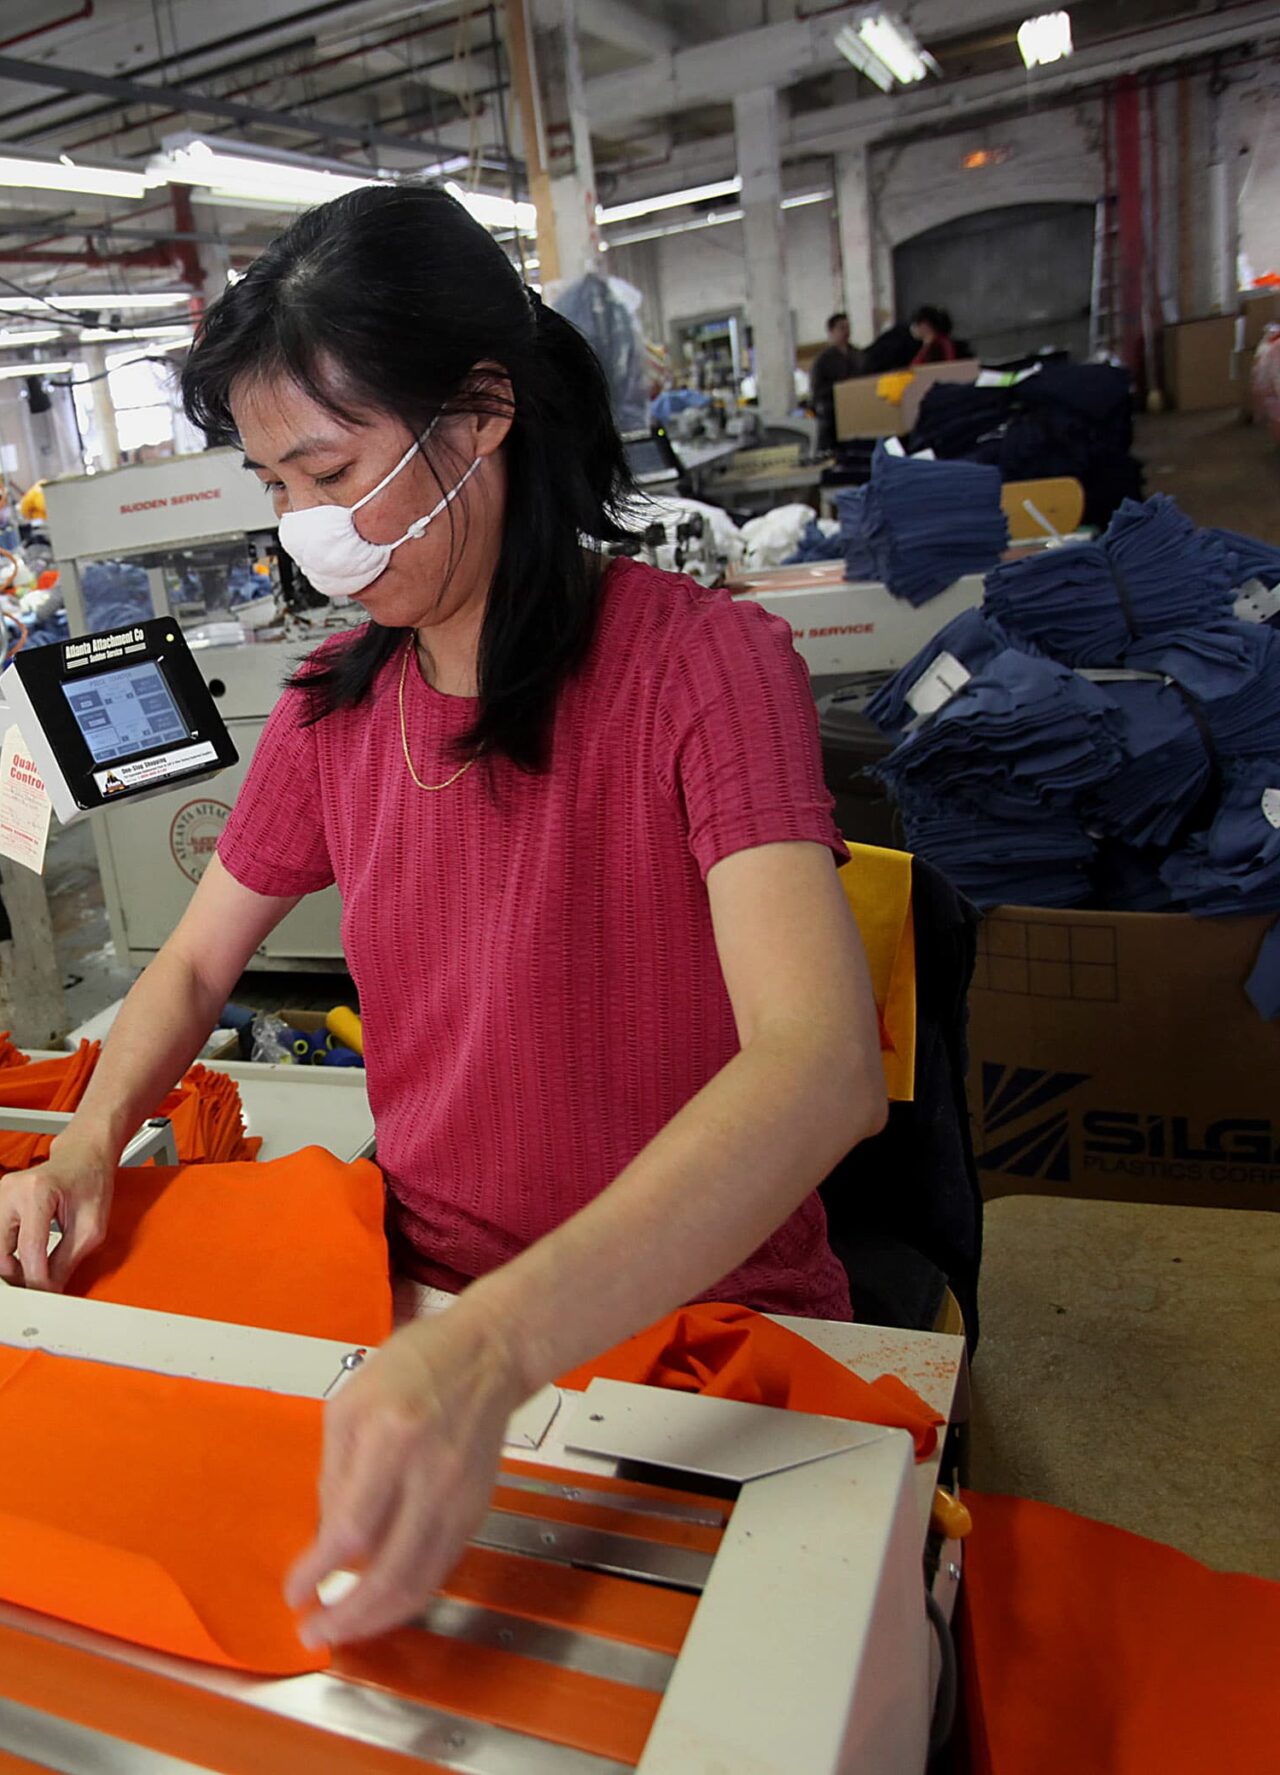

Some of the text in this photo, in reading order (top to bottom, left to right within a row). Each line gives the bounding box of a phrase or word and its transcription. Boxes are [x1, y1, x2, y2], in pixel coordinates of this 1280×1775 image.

[120, 487, 221, 514] SUDDEN SERVICE
[65, 627, 144, 660] Atlanta Attachment Co
[809, 622, 875, 638] SERVICE
[1083, 1110, 1280, 1165] SILG
[1083, 1155, 1203, 1181] PLASTICS
